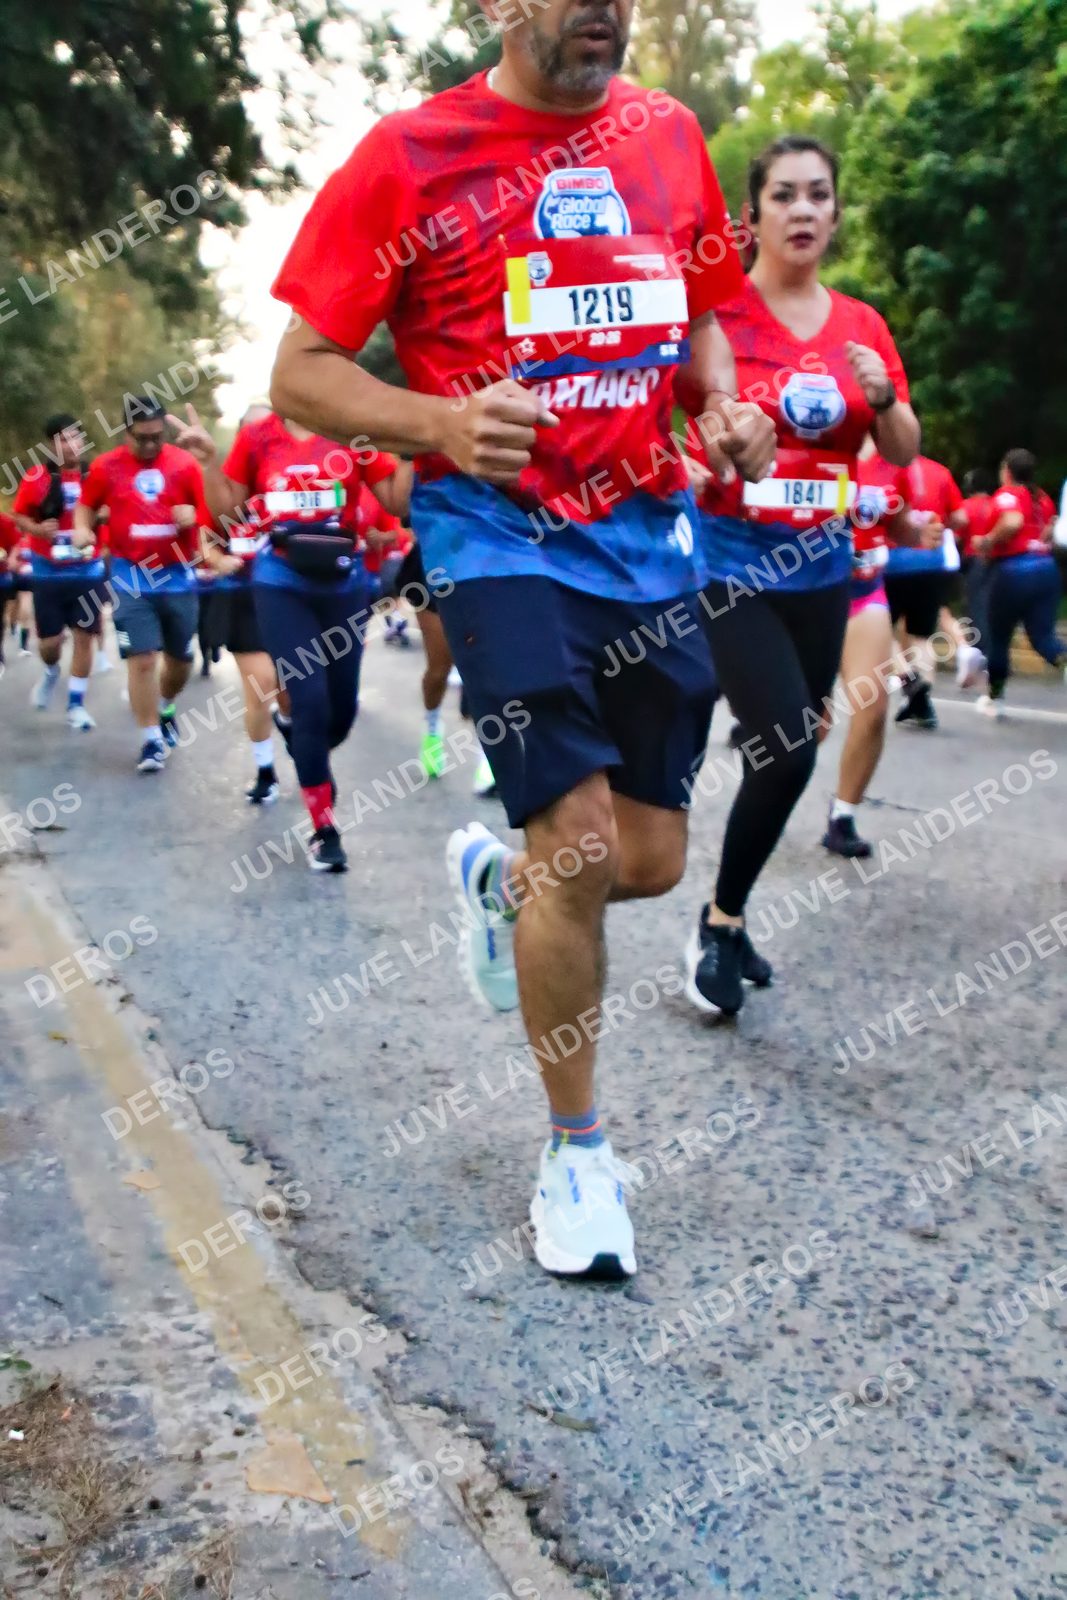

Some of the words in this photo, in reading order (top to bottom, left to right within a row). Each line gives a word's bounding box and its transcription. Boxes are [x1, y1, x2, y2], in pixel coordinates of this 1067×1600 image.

[556, 178, 604, 190] BIMBO
[558, 195, 606, 214] Global
[551, 213, 592, 230] Race
[568, 286, 635, 326] 1219
[783, 481, 824, 505] 1841
